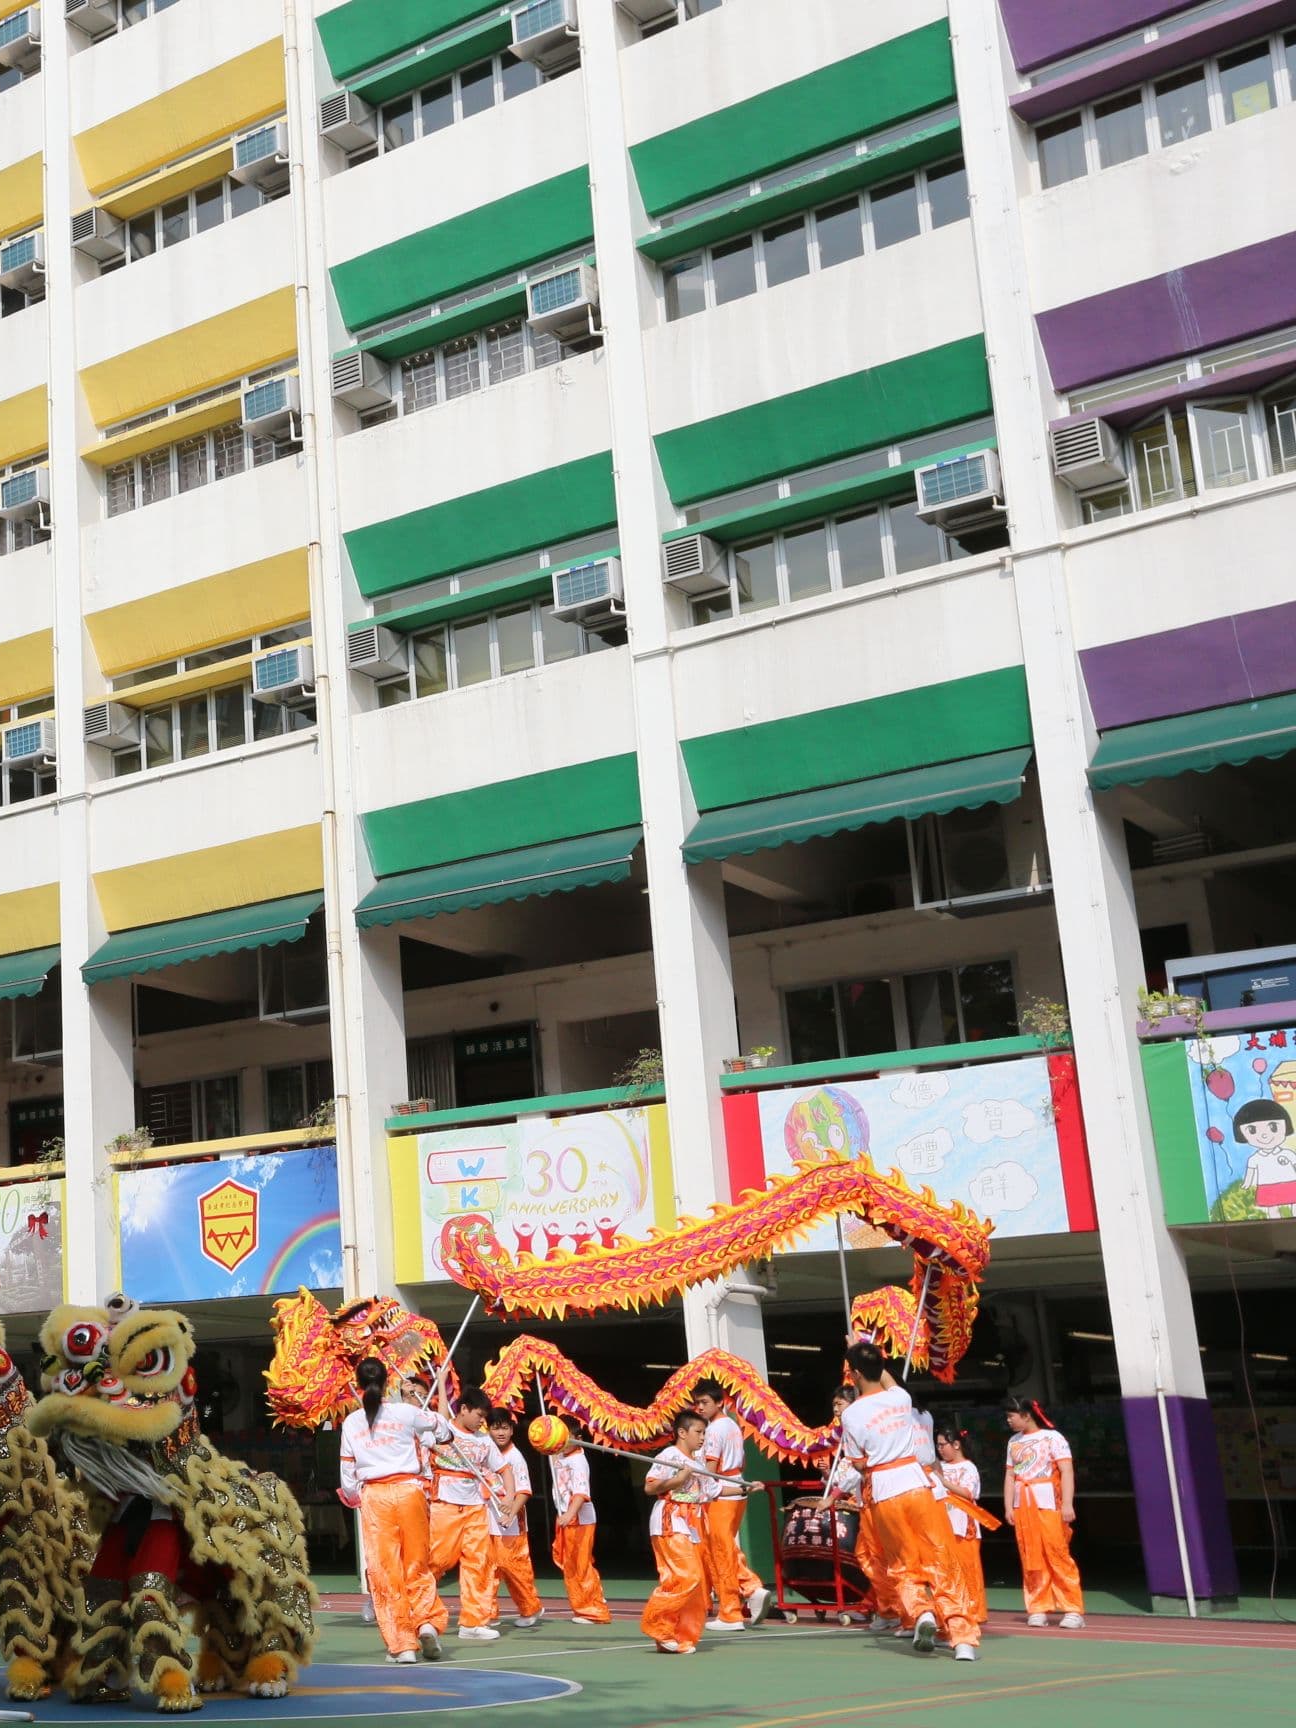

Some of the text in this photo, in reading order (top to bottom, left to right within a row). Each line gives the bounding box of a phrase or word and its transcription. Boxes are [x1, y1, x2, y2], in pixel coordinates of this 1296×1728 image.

[908, 1079, 937, 1101] 德
[984, 1105, 1004, 1132] 智
[457, 1157, 485, 1177] W
[461, 1186, 480, 1208] K
[979, 1173, 1011, 1200] 群
